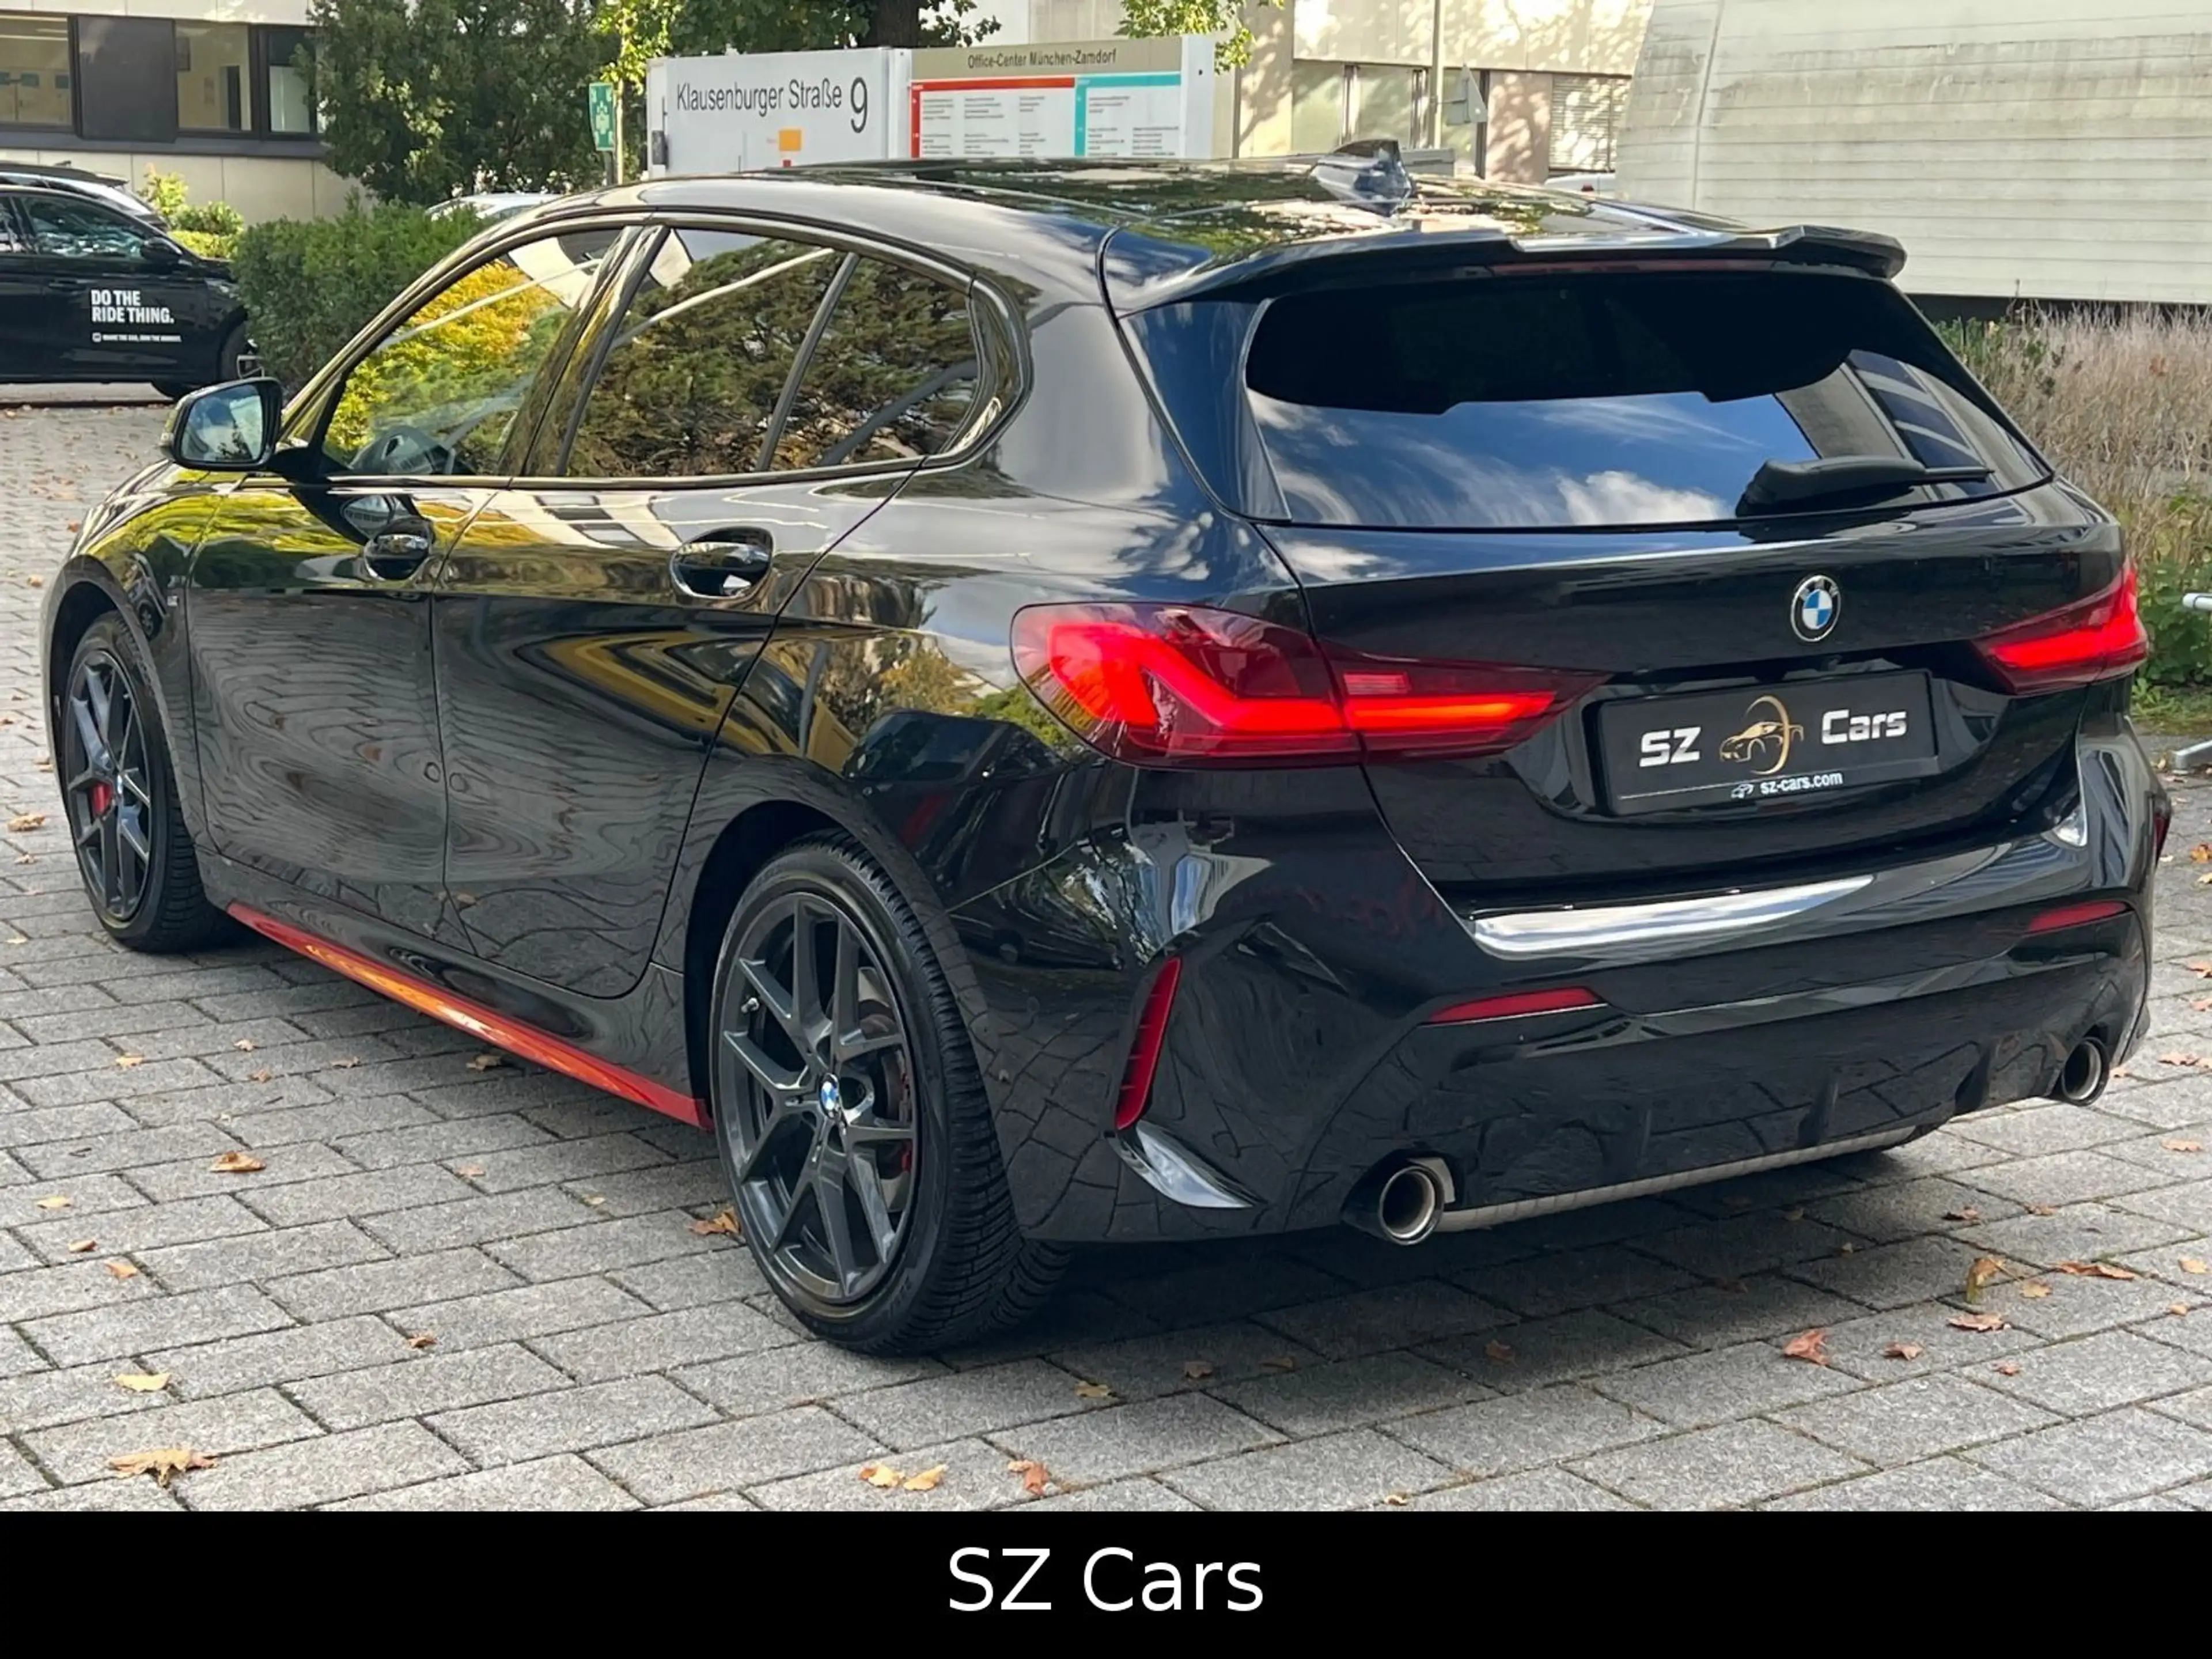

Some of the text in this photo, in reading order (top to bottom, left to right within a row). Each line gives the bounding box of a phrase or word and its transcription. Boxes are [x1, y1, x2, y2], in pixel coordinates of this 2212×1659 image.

[968, 52, 1027, 69] Office-Center
[676, 77, 868, 134] Klausenburger Straße 9
[90, 289, 141, 306] DO THE
[92, 306, 175, 324] RIDE THING.
[1639, 709, 1907, 767] SZ Cars
[1760, 772, 1843, 795] sz-cars.com
